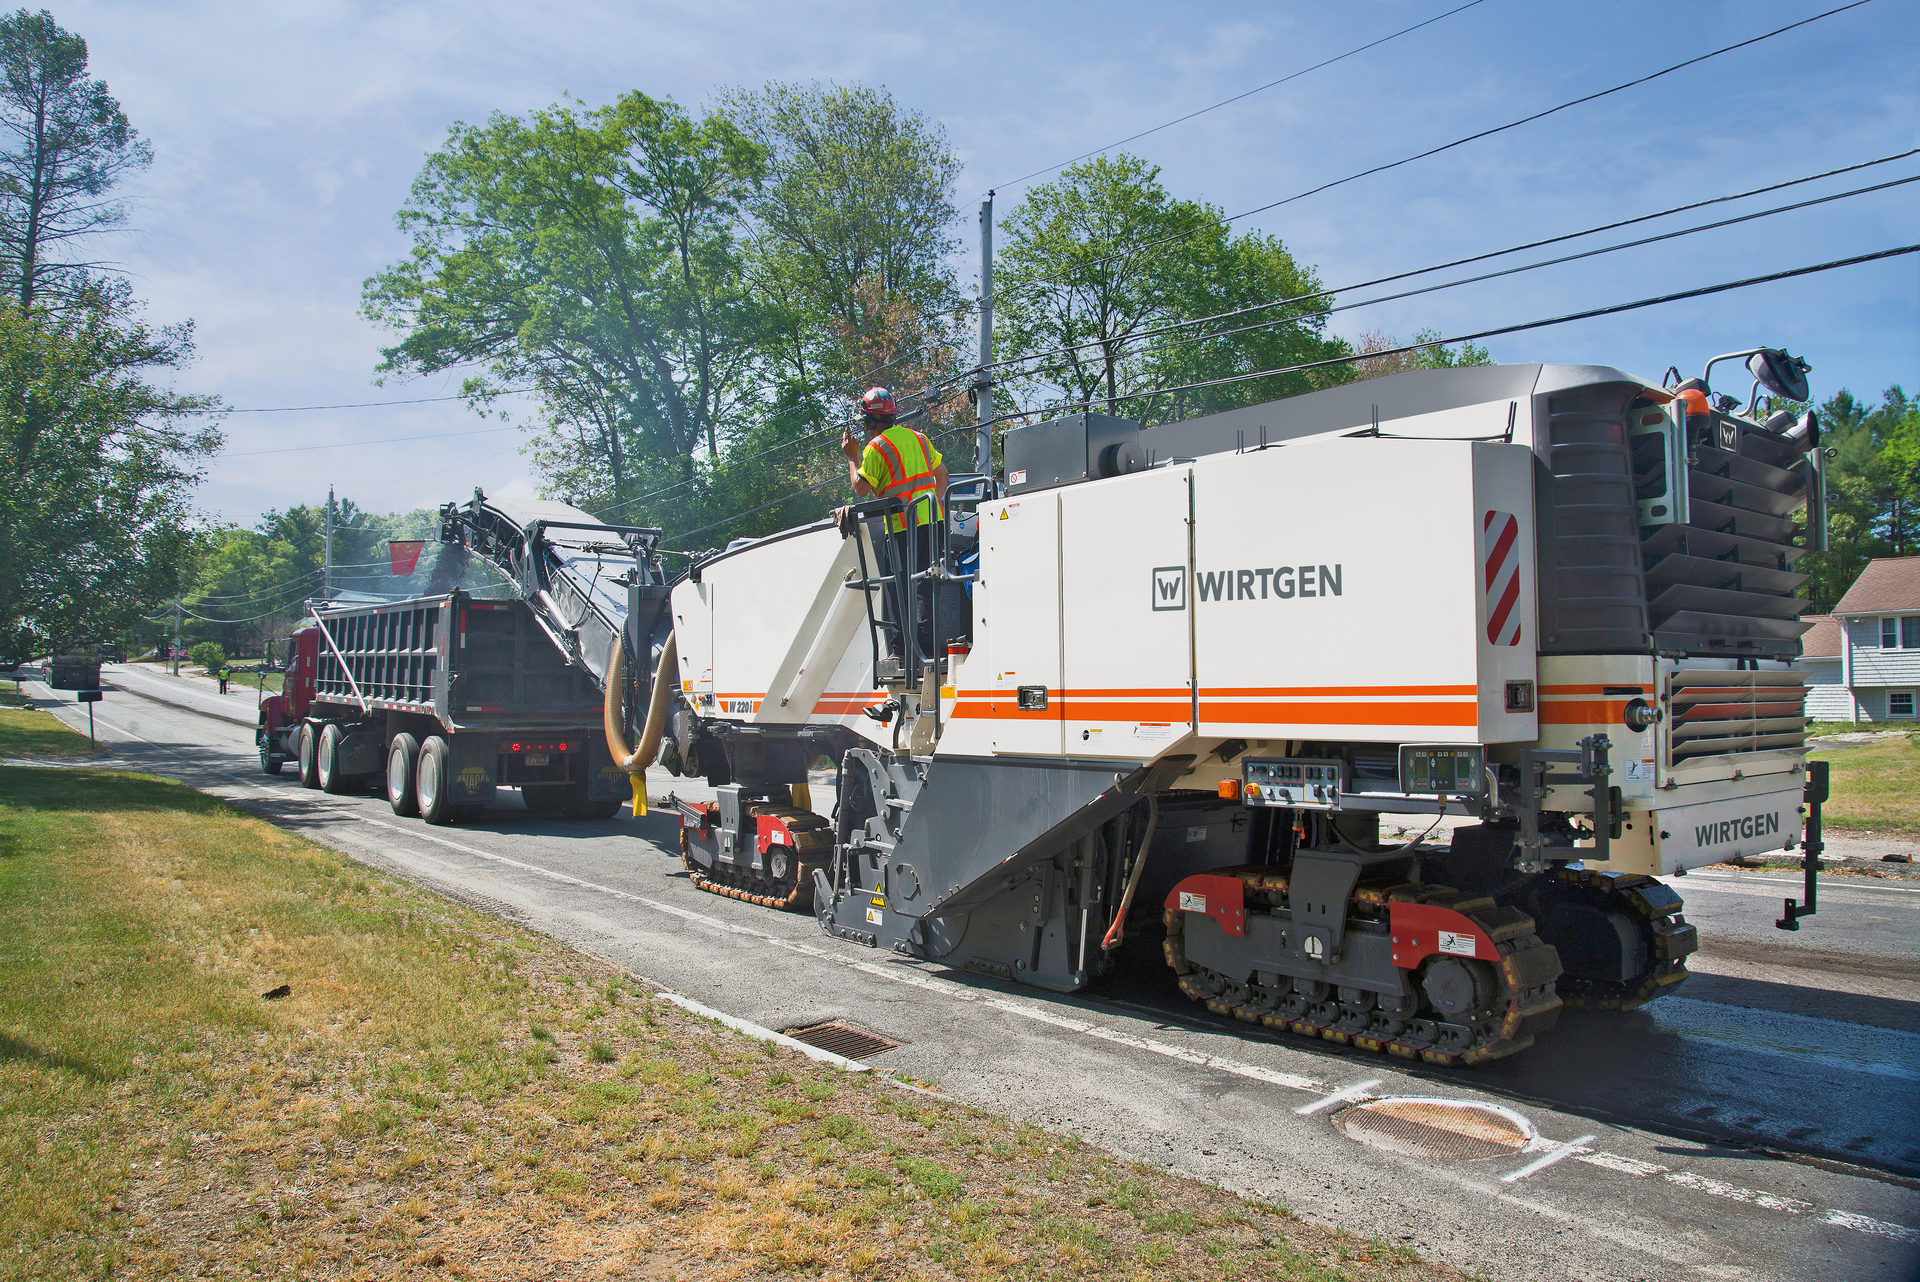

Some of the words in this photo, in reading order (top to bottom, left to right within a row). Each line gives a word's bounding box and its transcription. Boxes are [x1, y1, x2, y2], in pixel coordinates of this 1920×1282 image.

[1196, 563, 1342, 602] WIRTGEN
[729, 700, 737, 714] W
[737, 700, 753, 714] 220i
[1695, 811, 1779, 848] WIRTGEN
